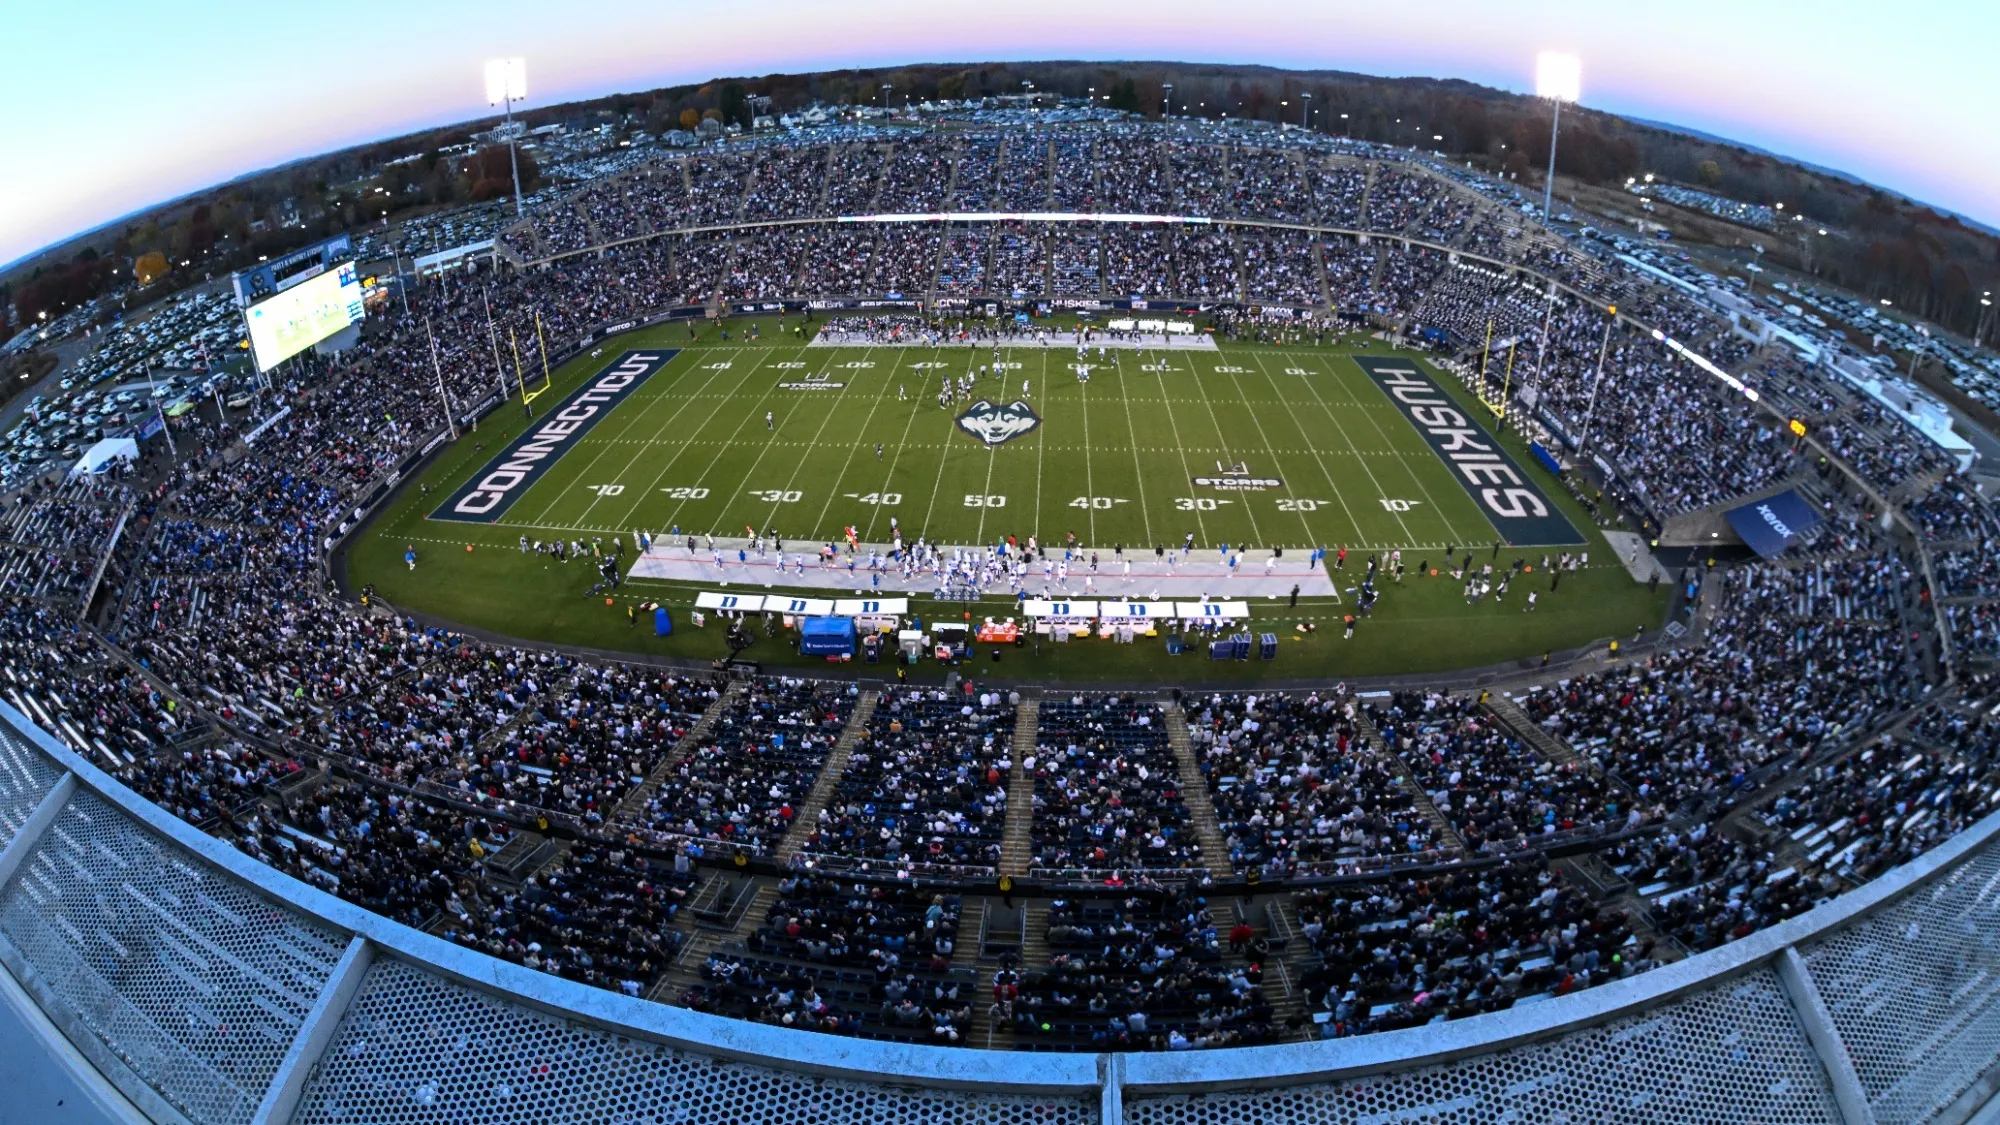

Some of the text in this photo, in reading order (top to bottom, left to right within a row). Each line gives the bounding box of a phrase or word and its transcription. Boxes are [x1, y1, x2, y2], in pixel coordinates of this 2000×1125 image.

[808, 300, 844, 309] M&T Bank
[1050, 299, 1101, 308] HUSKIES
[777, 361, 806, 369] 20
[1285, 367, 1308, 376] 10
[454, 353, 660, 514] CONNECTICUT
[1373, 367, 1548, 518] HUSKIES
[1195, 478, 1280, 487] STORRS
[597, 484, 625, 497] 10
[669, 487, 710, 500] 20
[761, 489, 803, 503] 30
[859, 492, 902, 506] 40
[963, 494, 1006, 508] 50
[1068, 496, 1112, 509] 40
[1174, 497, 1218, 511] 30
[1275, 499, 1317, 512] 20
[1379, 498, 1410, 512] 10
[1755, 503, 1795, 539] xerox
